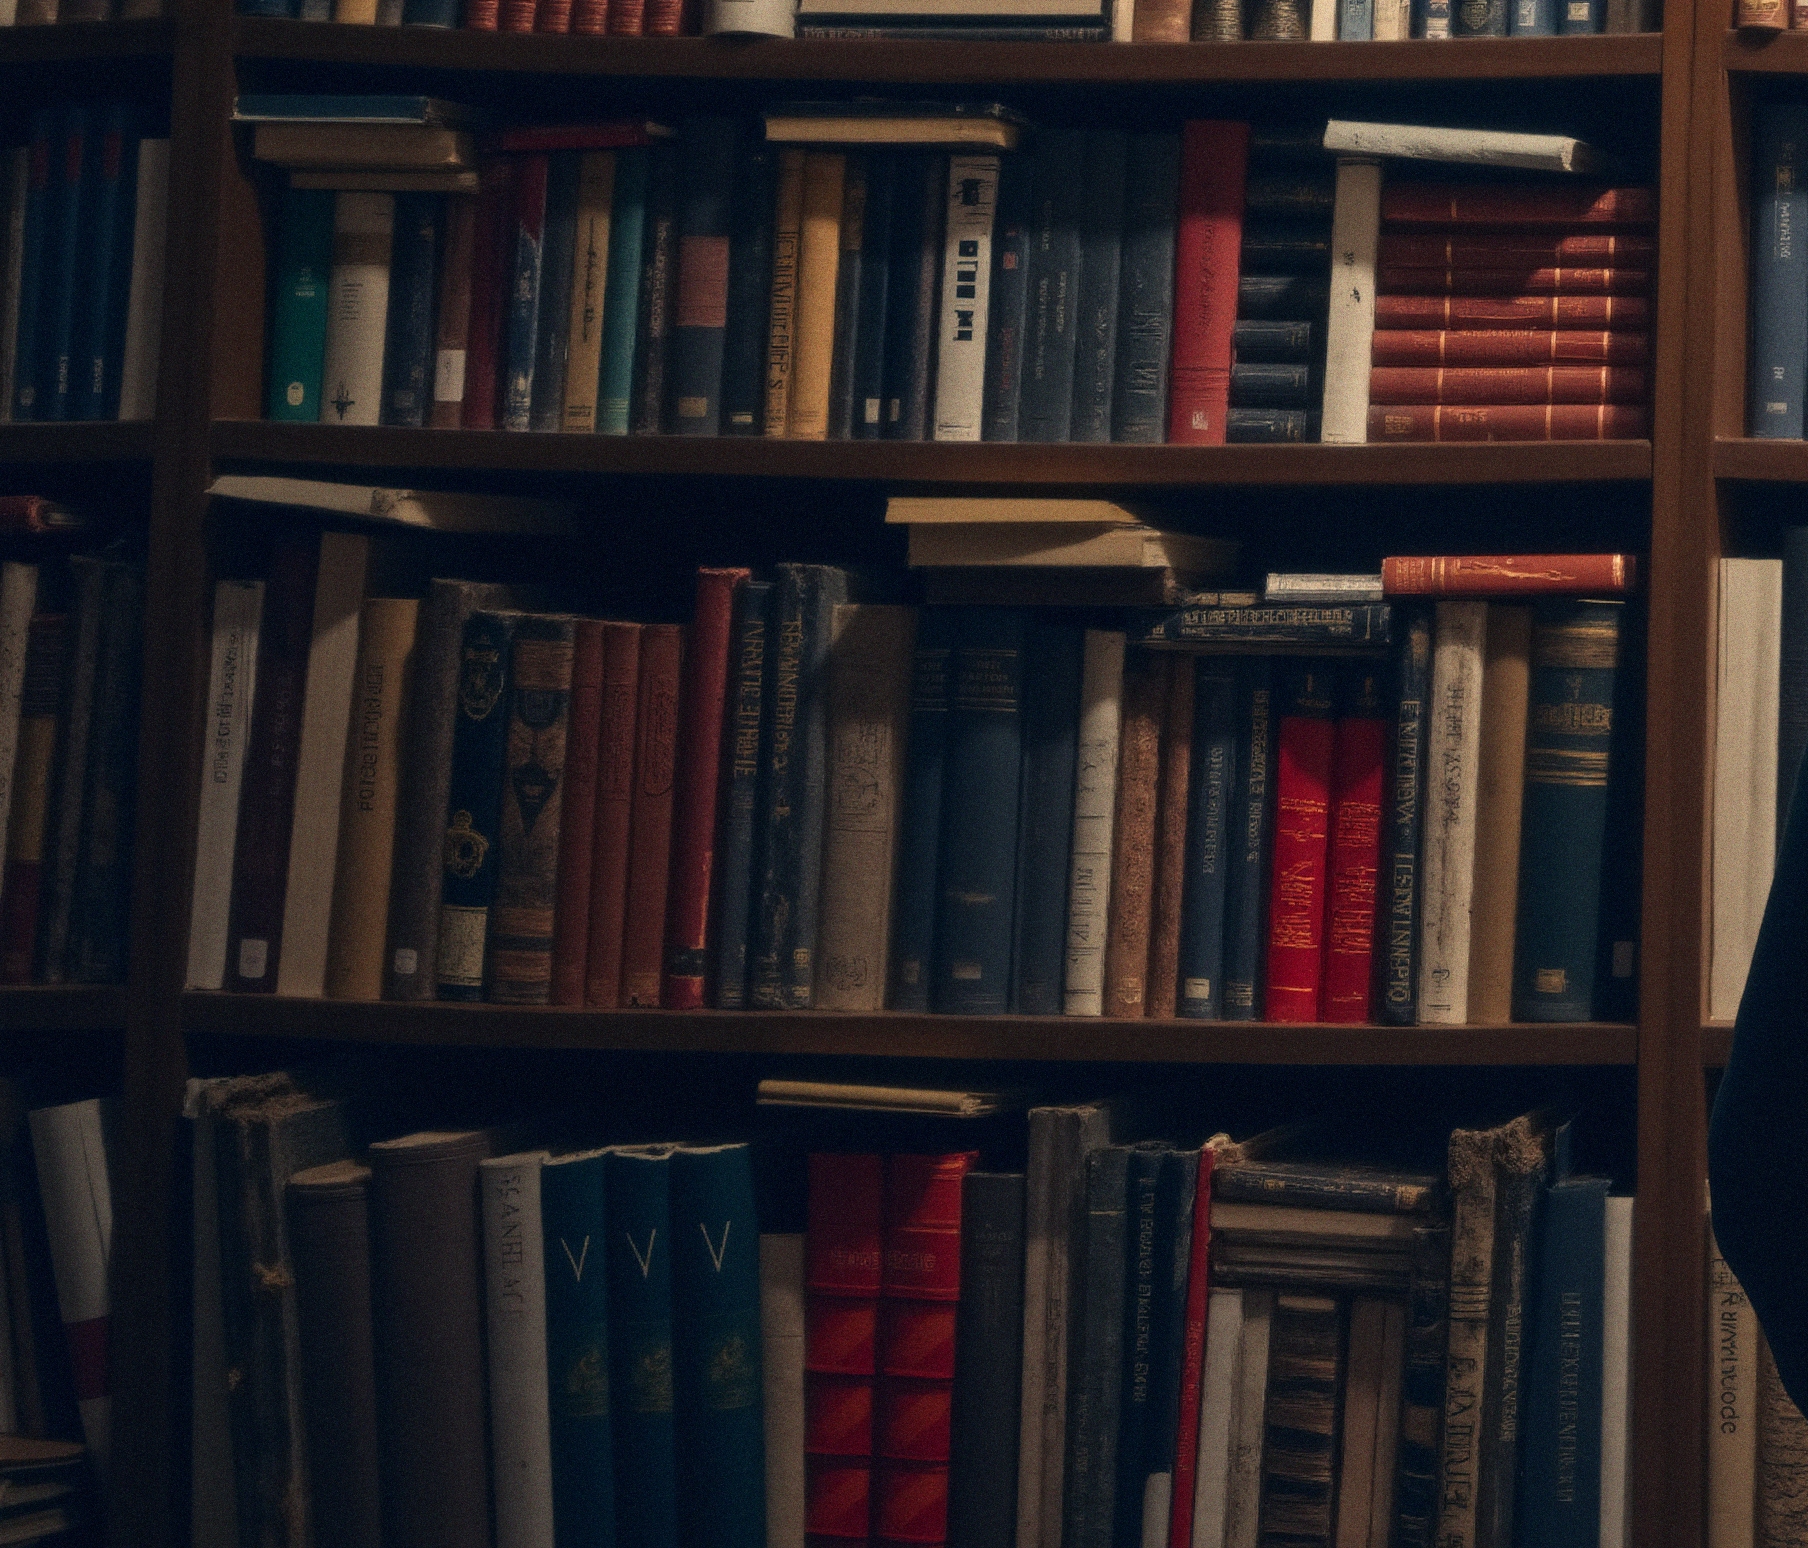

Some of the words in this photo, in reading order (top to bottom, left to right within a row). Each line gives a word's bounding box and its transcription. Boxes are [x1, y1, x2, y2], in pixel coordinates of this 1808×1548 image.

[561, 1234, 590, 1283] V
[626, 1227, 657, 1279] V
[700, 1219, 732, 1273] V
